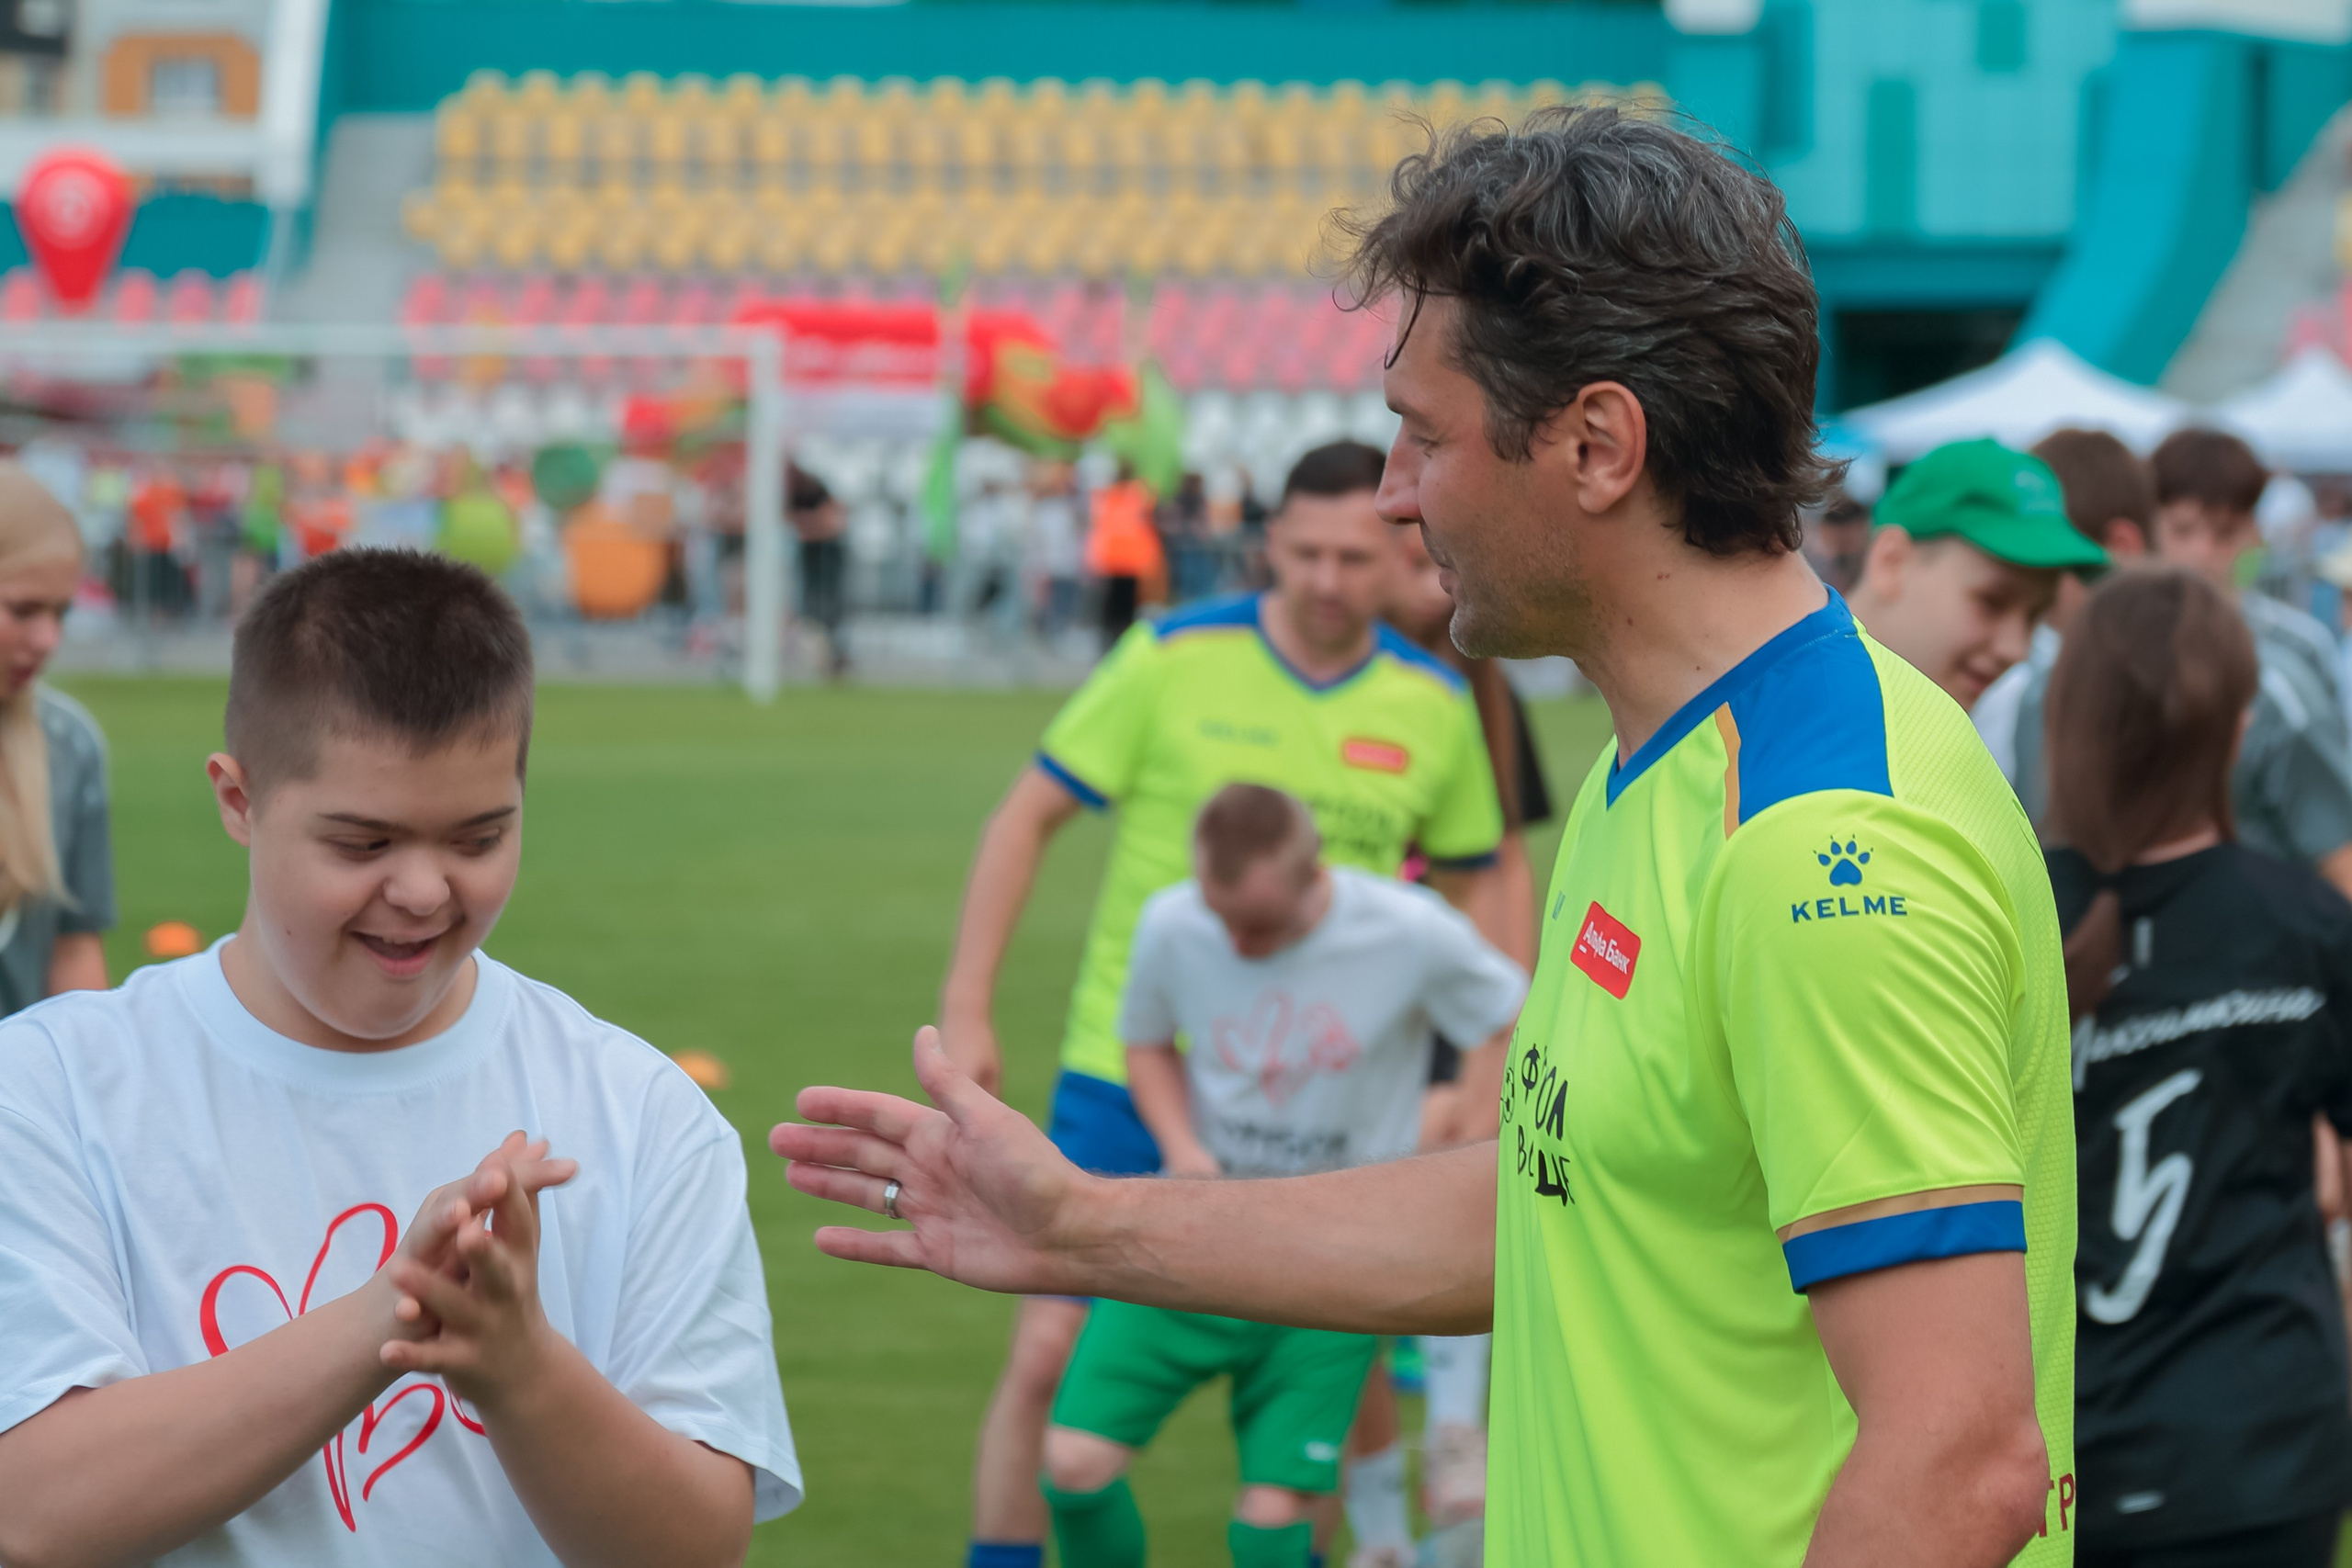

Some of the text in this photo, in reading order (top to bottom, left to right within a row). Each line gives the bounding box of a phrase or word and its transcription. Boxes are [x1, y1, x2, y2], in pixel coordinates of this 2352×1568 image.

[1792, 895, 1907, 923] KELME
[1604, 938, 1630, 975] Банк
[2084, 1068, 2203, 1324] 5
